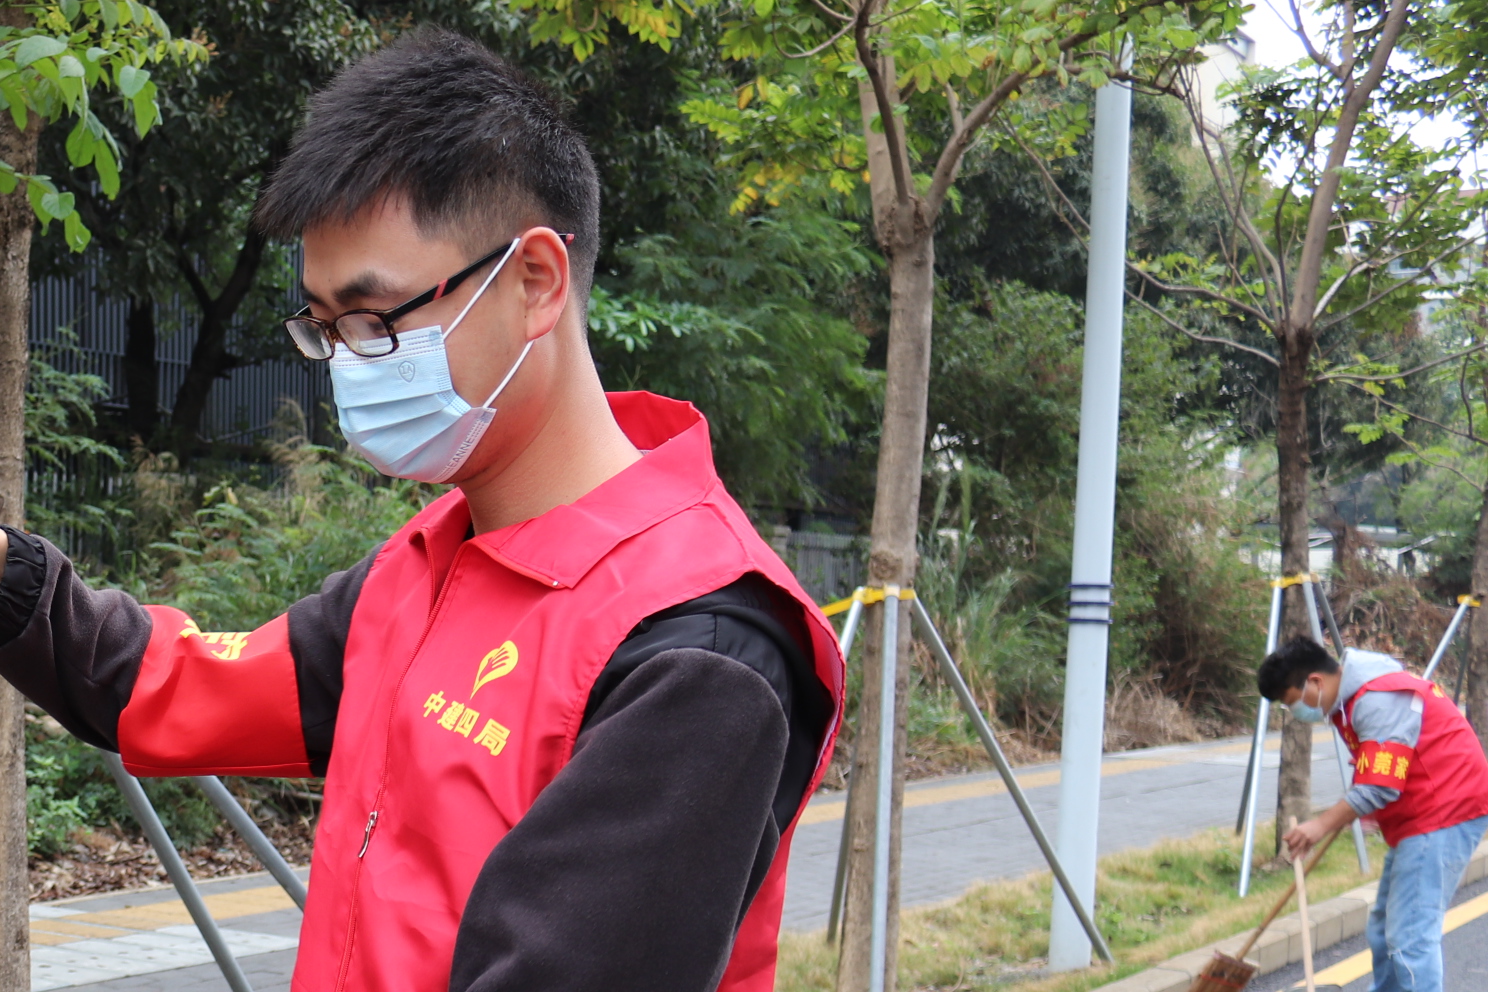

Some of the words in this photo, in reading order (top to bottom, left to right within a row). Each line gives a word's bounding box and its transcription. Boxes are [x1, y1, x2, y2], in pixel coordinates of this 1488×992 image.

[423, 690, 511, 757] 中建四局
[1356, 750, 1410, 780] 小莞家
